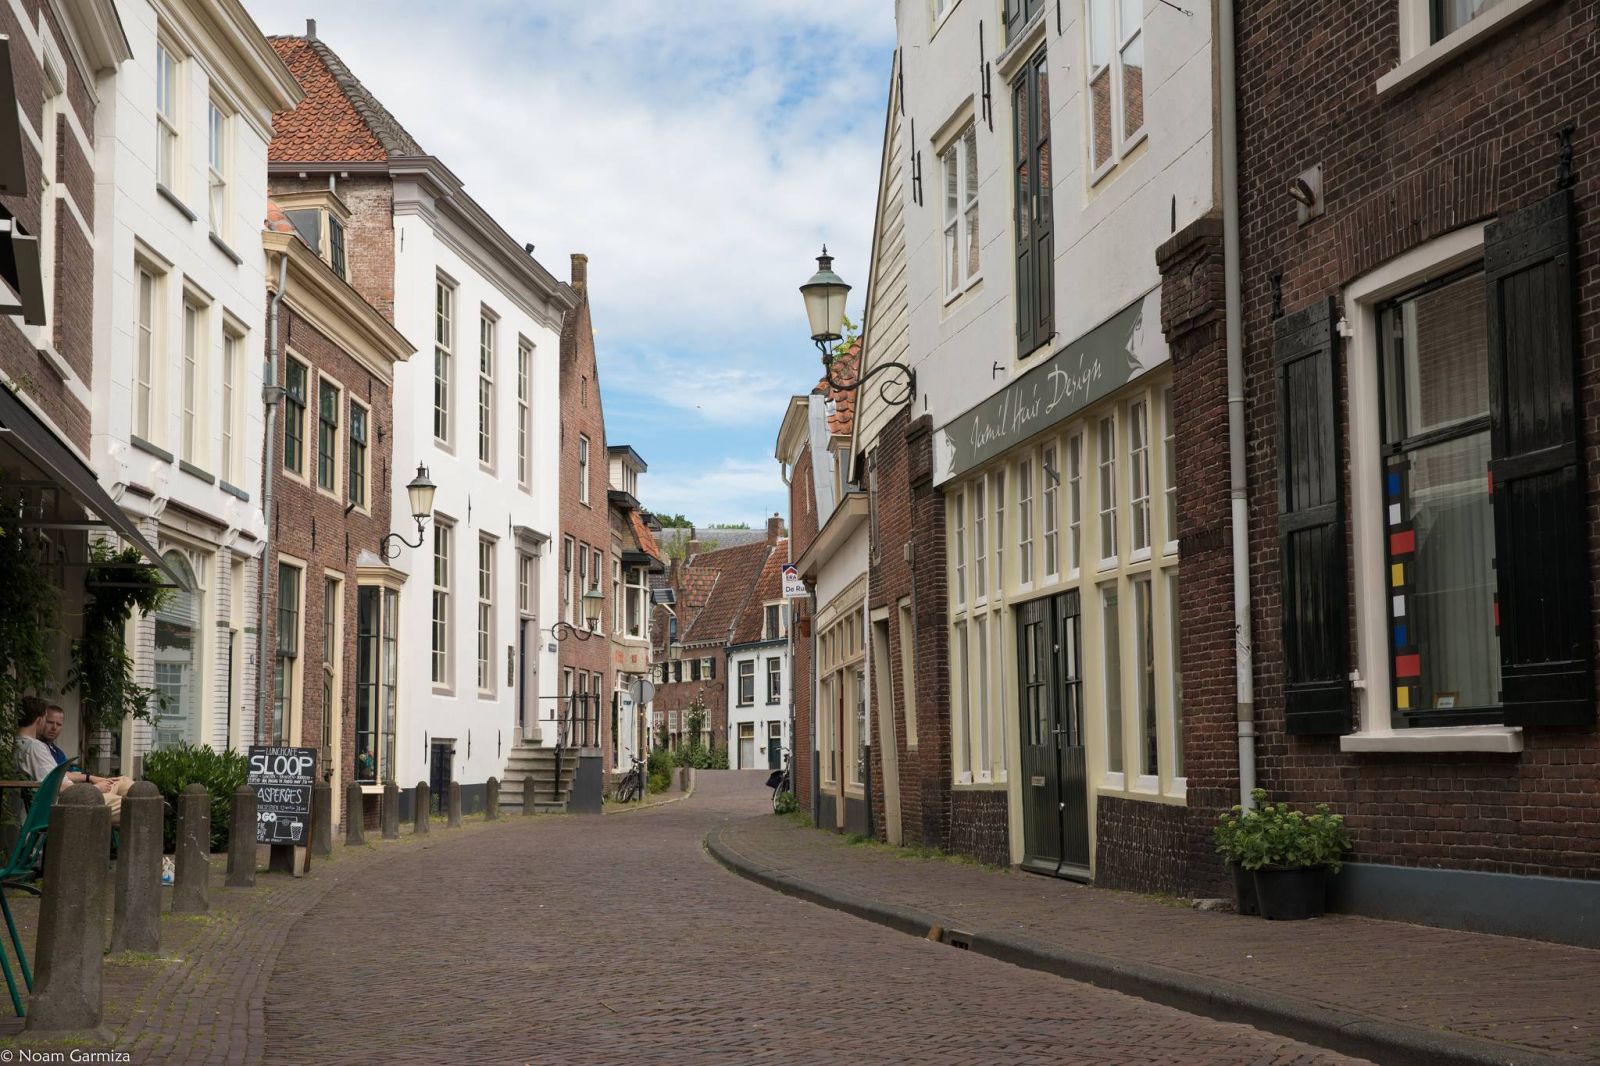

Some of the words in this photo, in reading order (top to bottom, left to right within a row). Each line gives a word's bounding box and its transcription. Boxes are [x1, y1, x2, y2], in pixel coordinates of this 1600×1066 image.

[1012, 384, 1041, 434] Hair
[1045, 353, 1102, 415] Design
[250, 755, 313, 775] SLOOP
[257, 787, 302, 804] ASPERGES
